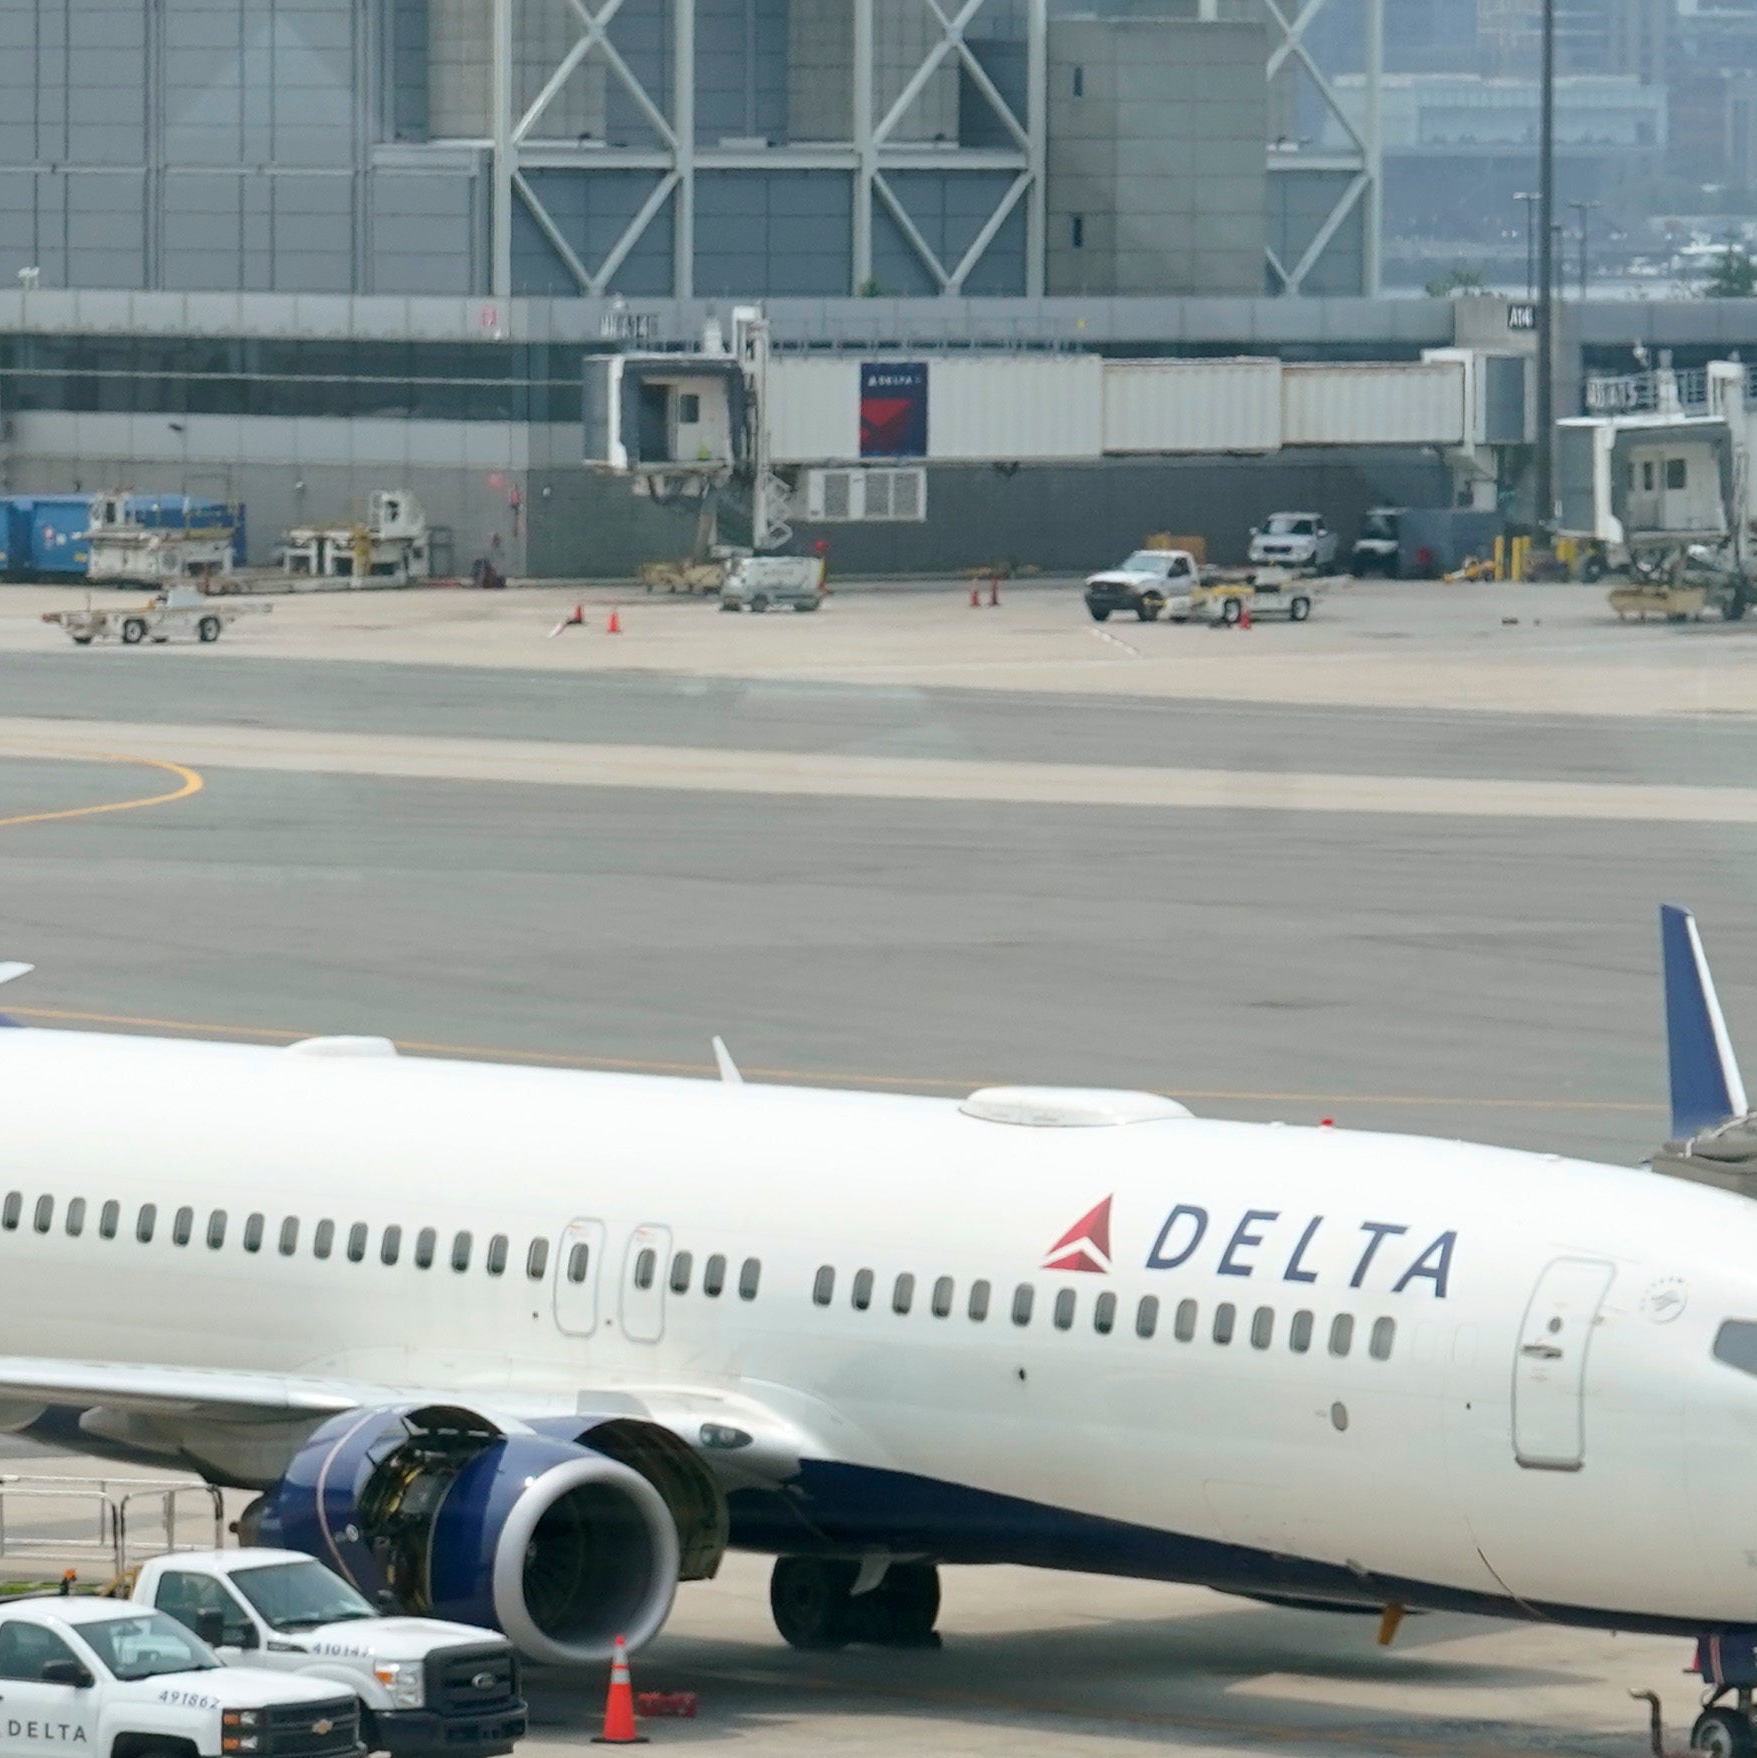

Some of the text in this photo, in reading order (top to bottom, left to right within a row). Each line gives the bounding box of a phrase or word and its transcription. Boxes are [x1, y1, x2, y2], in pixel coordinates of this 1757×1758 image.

[1145, 1203, 1459, 1299] DELTA
[158, 1689, 221, 1710] 491862
[7, 1720, 88, 1743] DELTA
